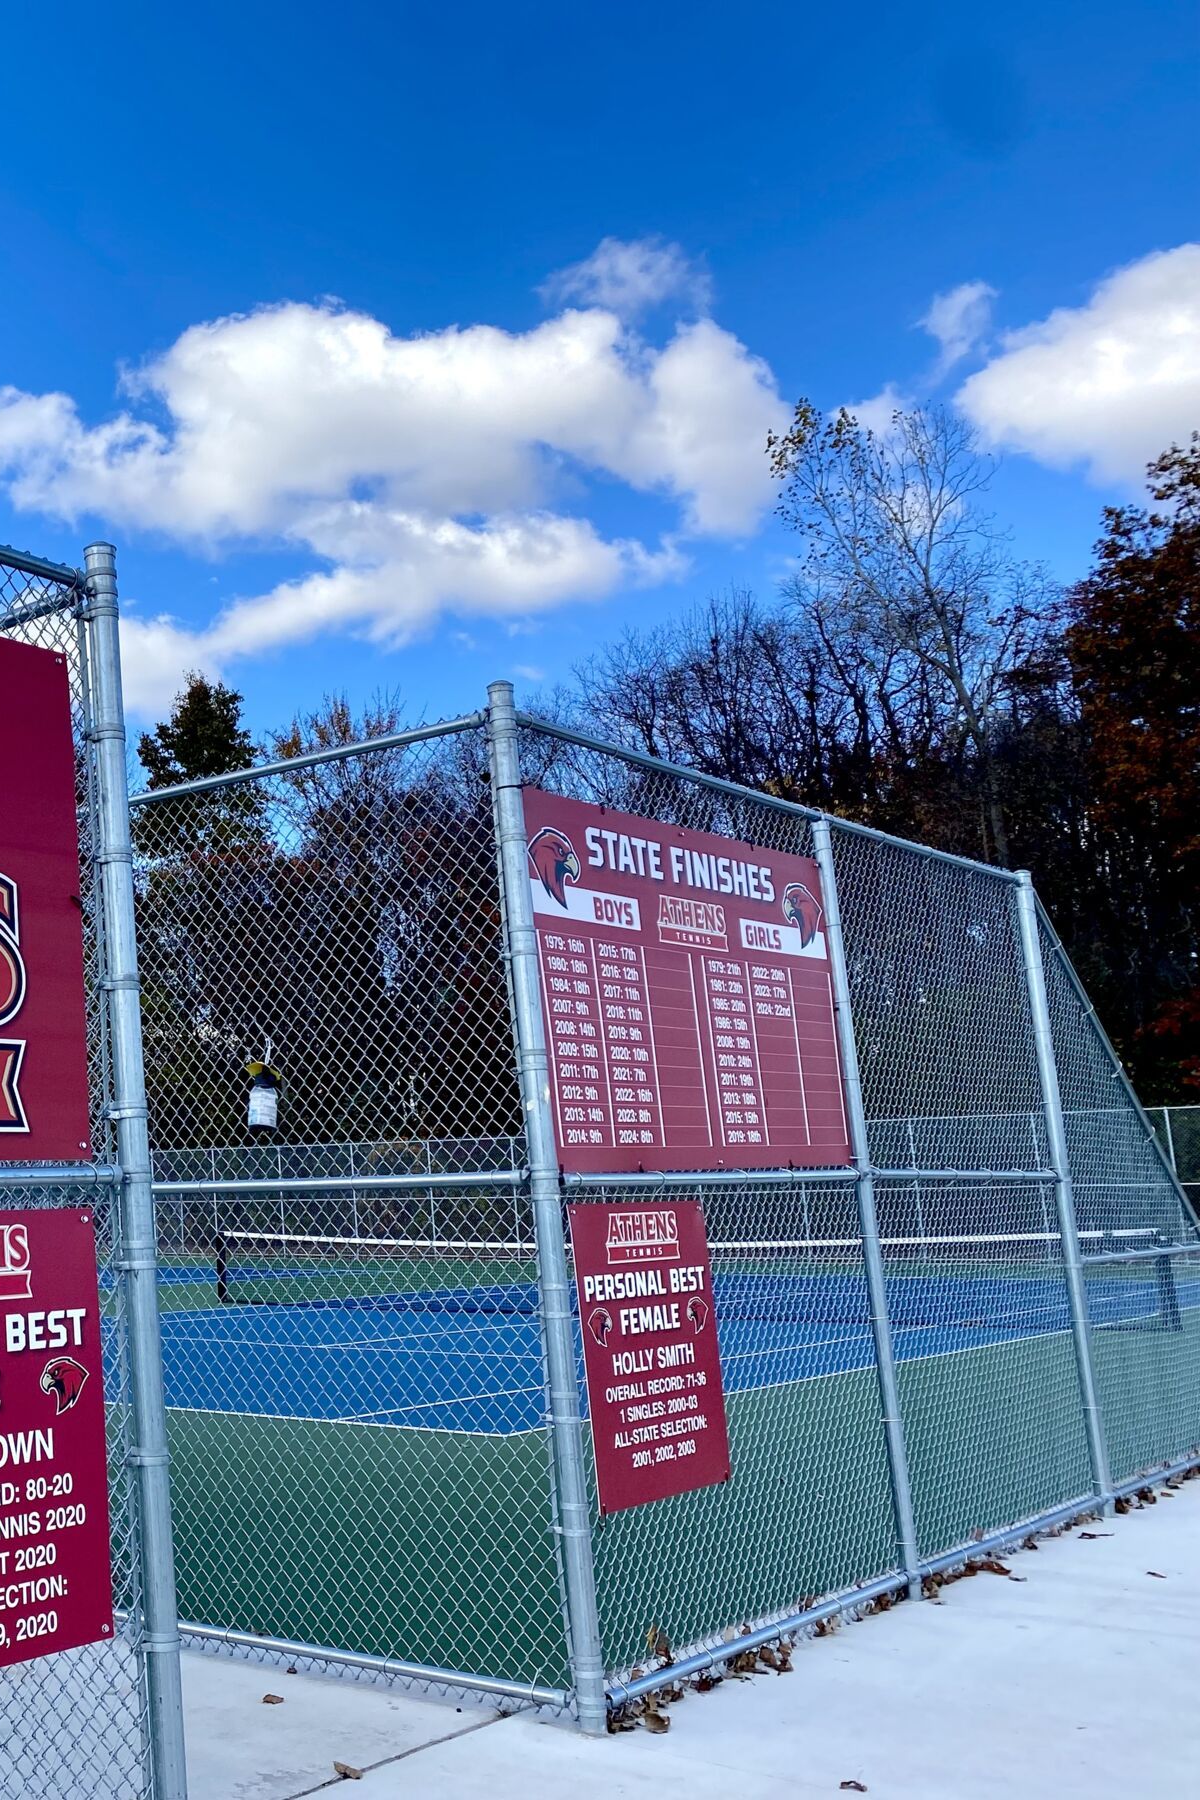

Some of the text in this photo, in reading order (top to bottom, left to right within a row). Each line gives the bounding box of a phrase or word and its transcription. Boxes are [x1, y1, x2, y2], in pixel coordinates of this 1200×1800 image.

[584, 826, 776, 902] STATE FINISHES
[592, 896, 634, 926] BOYS
[658, 895, 726, 935] ATHENS
[544, 935, 585, 953] 1979: 16th
[676, 932, 712, 945] TENNIS
[744, 924, 782, 950] GIRLS
[598, 944, 636, 961] 2015: 17th
[547, 956, 569, 971] 1980:
[601, 964, 639, 980] 2016: 12th
[550, 978, 572, 992] 1984:
[604, 984, 640, 1000] 2017: 11th
[552, 999, 589, 1015] 2007: 9th
[628, 1007, 643, 1021] 11th
[774, 1004, 791, 1016] 22nd
[579, 1022, 596, 1036] 14th
[608, 1026, 642, 1040] 2019: 9th
[558, 1042, 598, 1058] 2009: 15th
[611, 1046, 648, 1061] 2020: 10th
[560, 1064, 598, 1079] 2011: 17th
[613, 1067, 646, 1082] 2021: 7th
[562, 1085, 598, 1100] 2012: 9th
[615, 1088, 635, 1102] 2022:
[564, 1108, 604, 1122] 2013: 14th
[617, 1109, 637, 1122] 2023:
[567, 1129, 602, 1143] 2014: 9th
[619, 1130, 639, 1143] 2024:
[606, 1211, 678, 1245] ATHENS
[626, 1248, 663, 1258] TENNIS
[584, 1266, 704, 1302] PERSONAL BEST
[620, 1303, 680, 1336] FEMALE
[5, 1308, 86, 1352] BEST
[612, 1342, 694, 1376] HOLLY SMITH
[606, 1372, 706, 1404] OVERALL RECORD: 71-36
[620, 1394, 698, 1424] 1 SINGLES: 2000-03
[614, 1414, 708, 1448] ALL-STATE SELECTION:
[632, 1440, 696, 1468] 2001, 2002, 2003
[26, 1472, 73, 1500] 80-20
[46, 1504, 86, 1531] 2020
[15, 1543, 56, 1572] 2020
[16, 1610, 58, 1642] 2020
